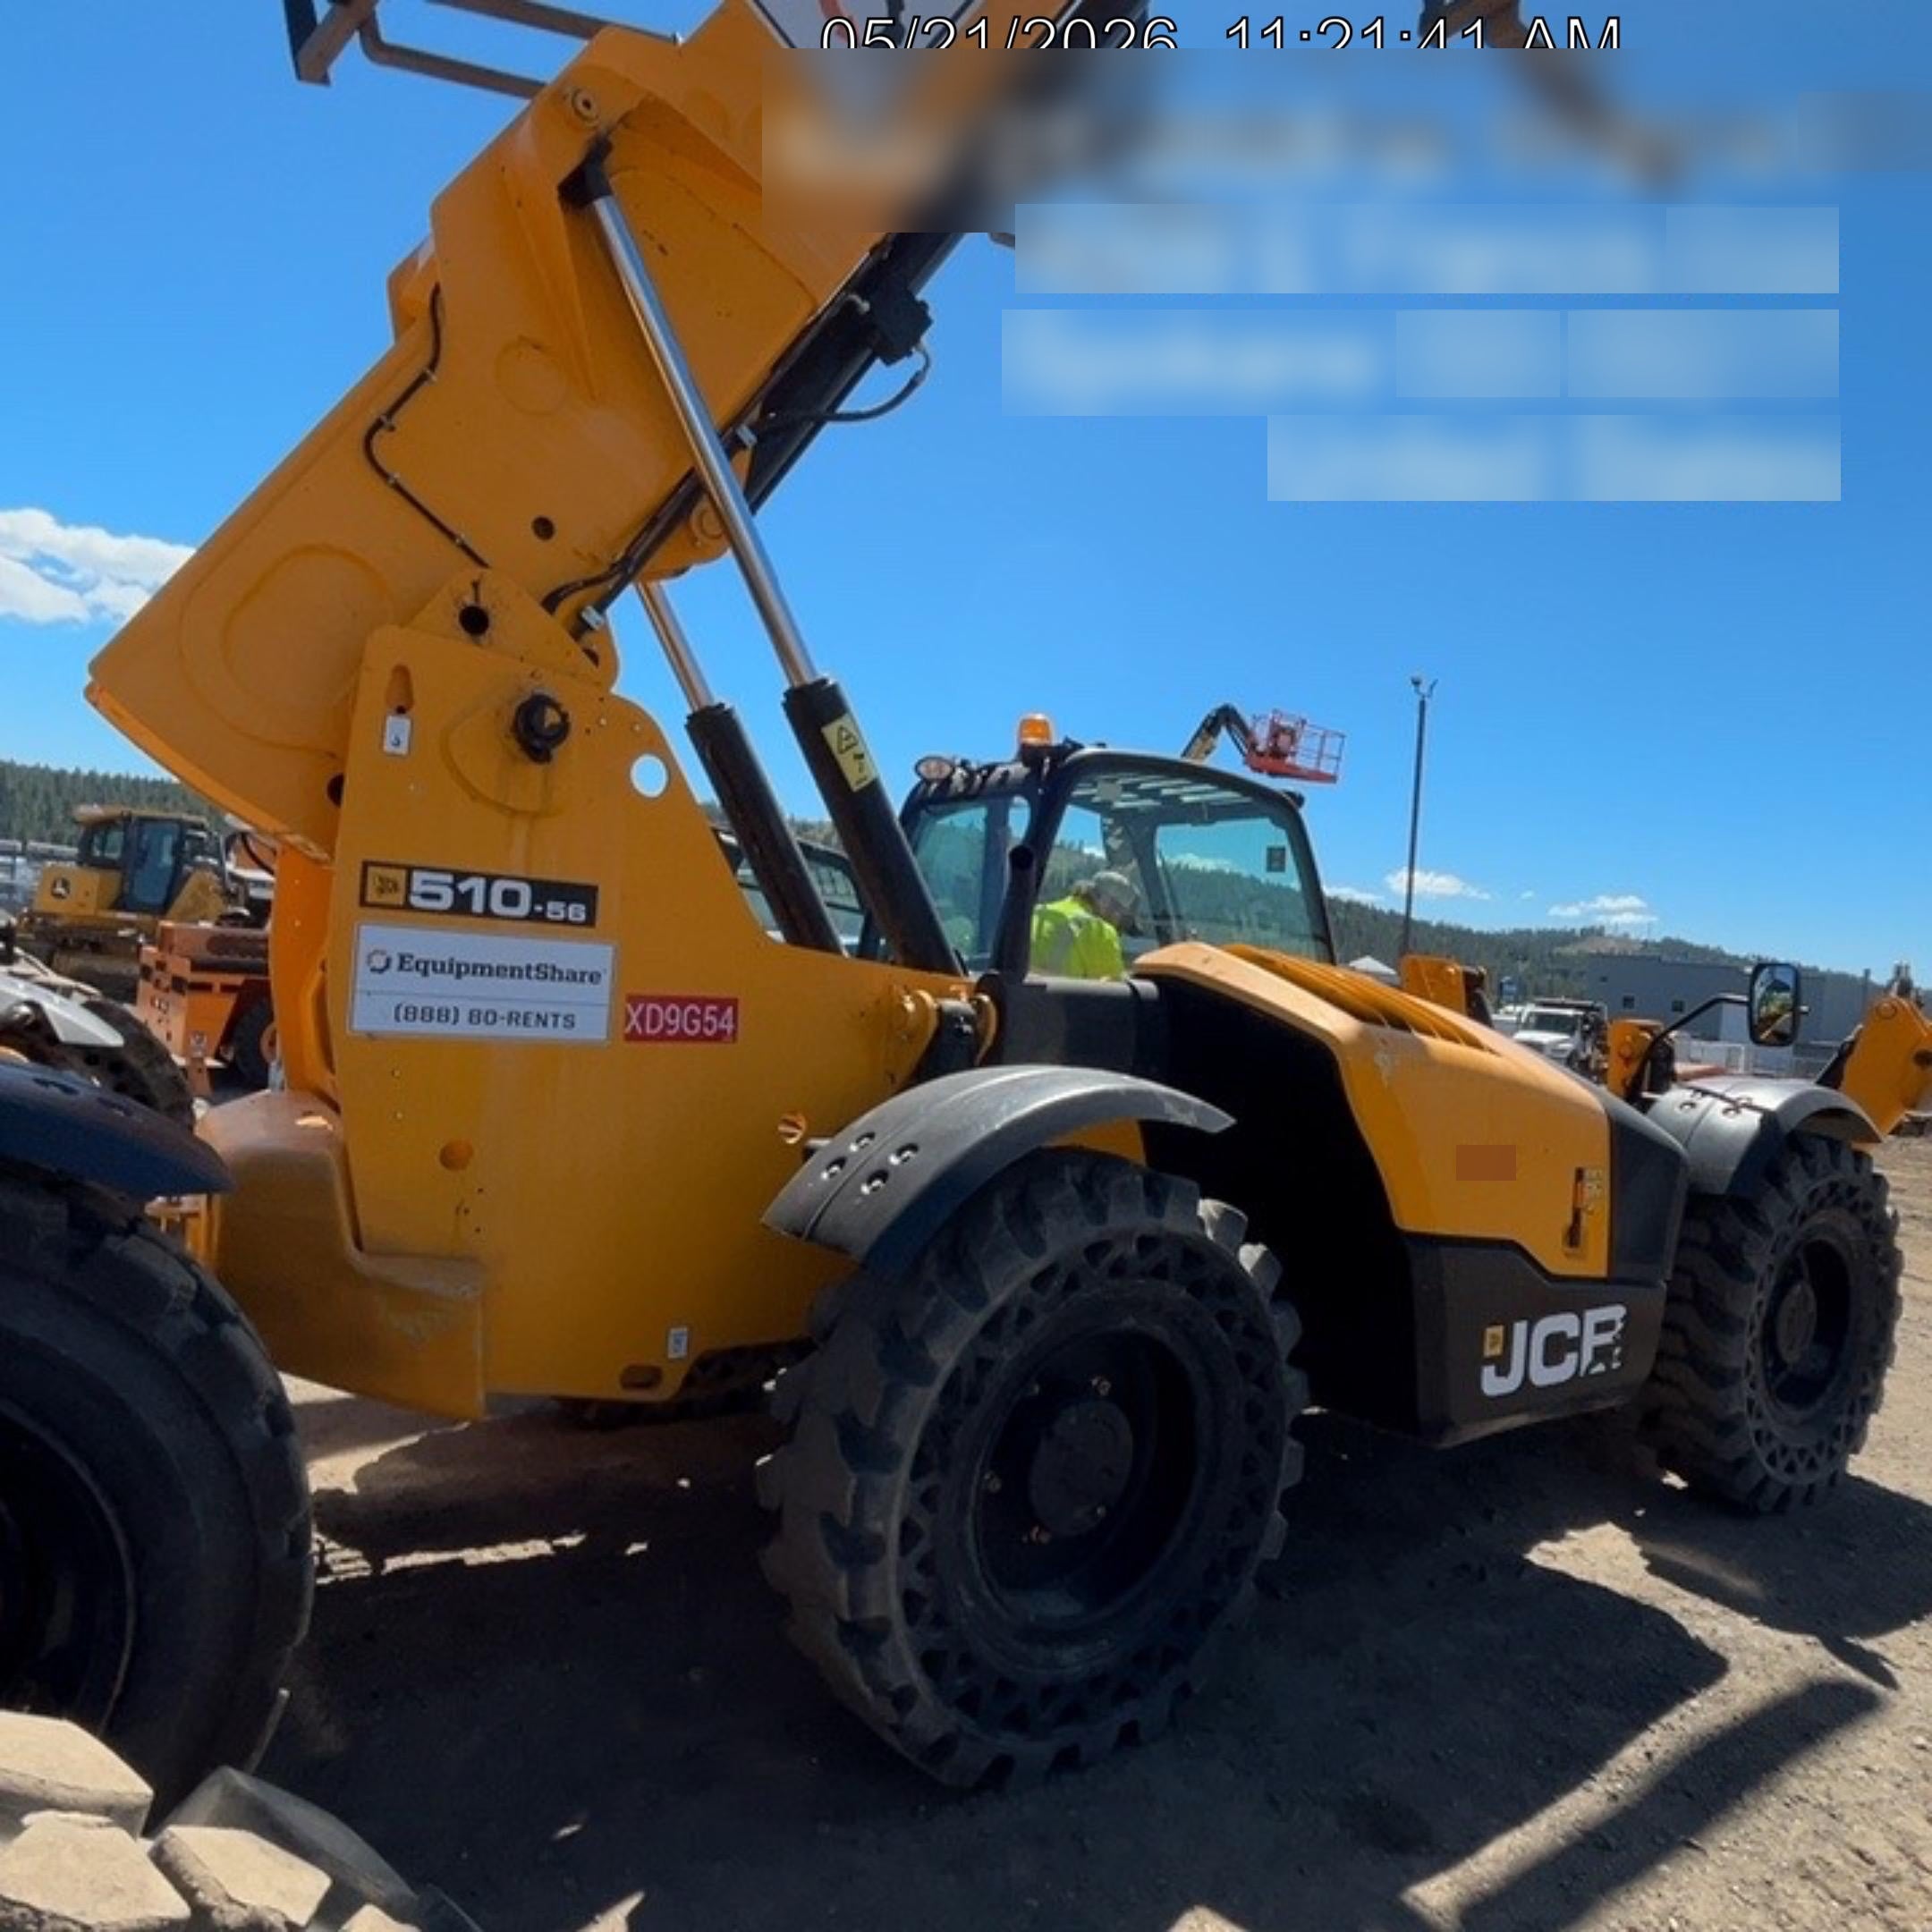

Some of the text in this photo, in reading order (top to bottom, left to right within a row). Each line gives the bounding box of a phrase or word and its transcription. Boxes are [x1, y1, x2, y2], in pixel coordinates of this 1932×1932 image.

[396, 952, 602, 986] EquipmentShare
[393, 1003, 576, 1030] (888) 80-RENTS
[627, 1003, 734, 1037] XD9G54
